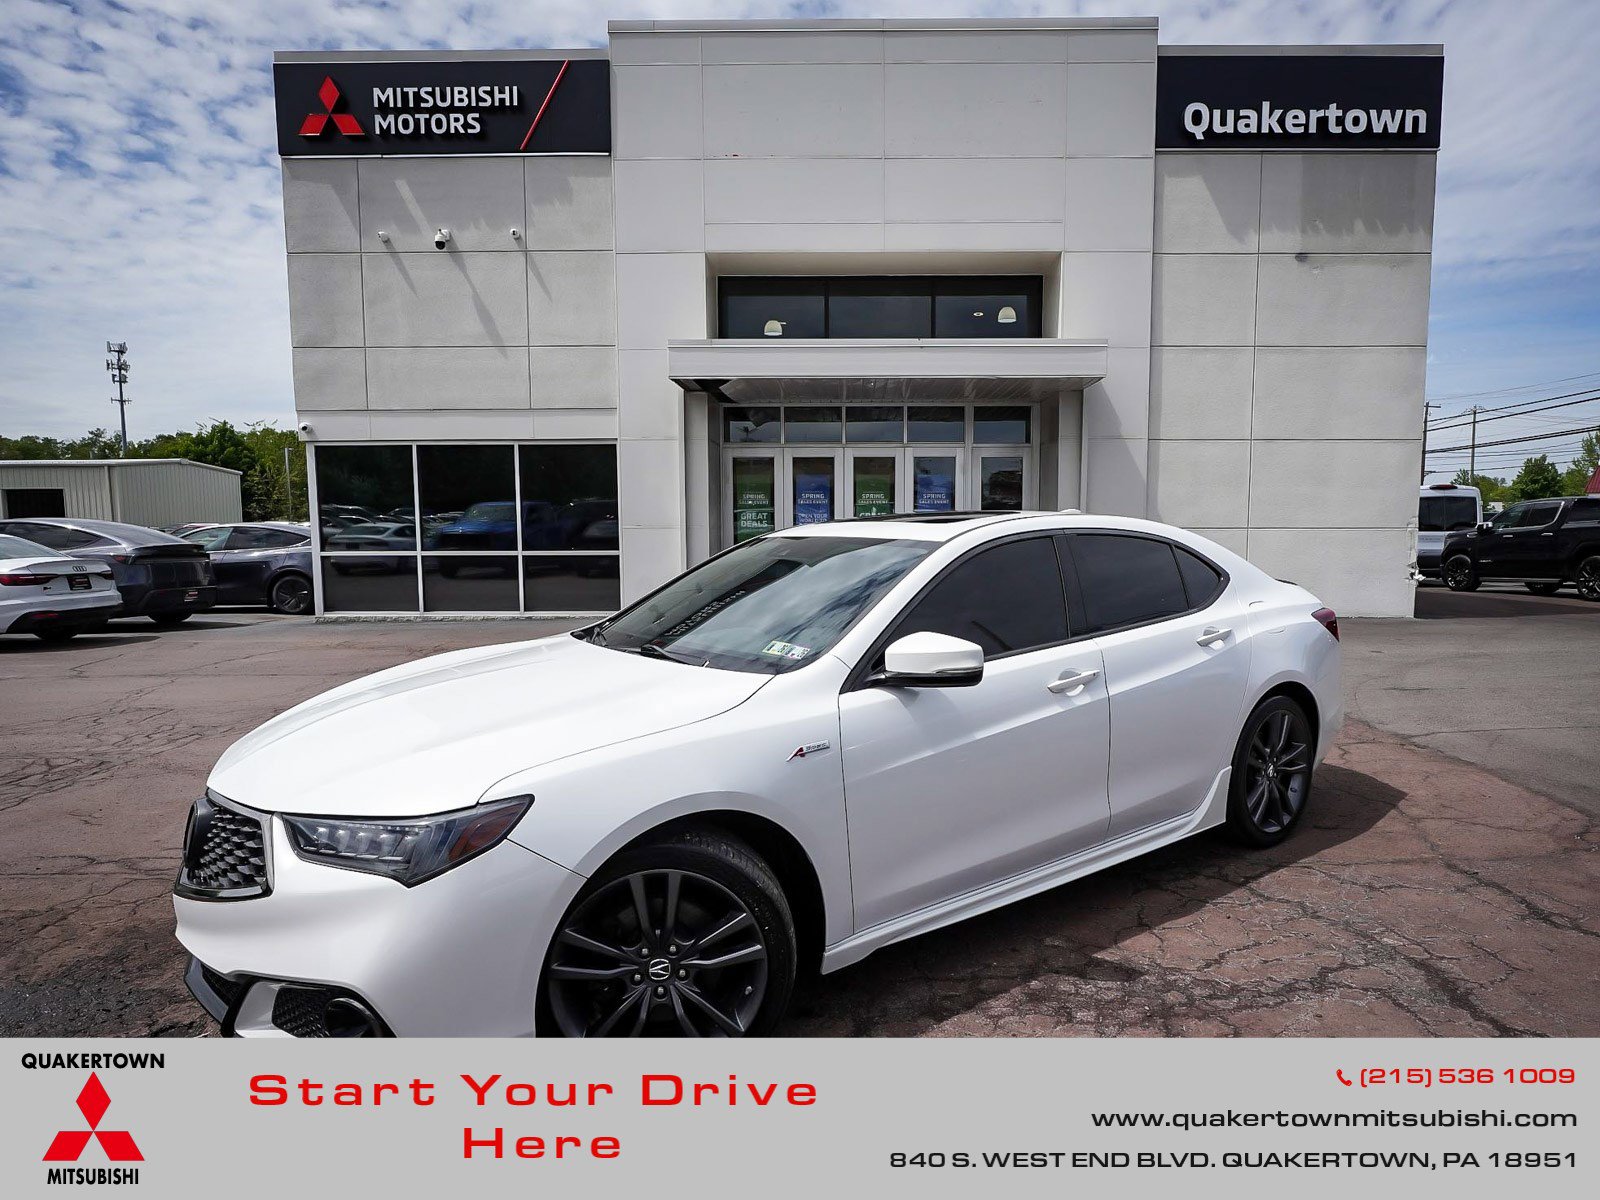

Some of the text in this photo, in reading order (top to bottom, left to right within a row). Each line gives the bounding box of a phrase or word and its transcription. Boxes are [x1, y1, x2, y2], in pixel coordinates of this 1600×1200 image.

[372, 85, 518, 108] MITSUBISHI
[374, 113, 481, 135] MOTORS
[1183, 101, 1427, 140] Quakertown
[740, 512, 768, 520] GREAT
[740, 520, 768, 528] DEALS
